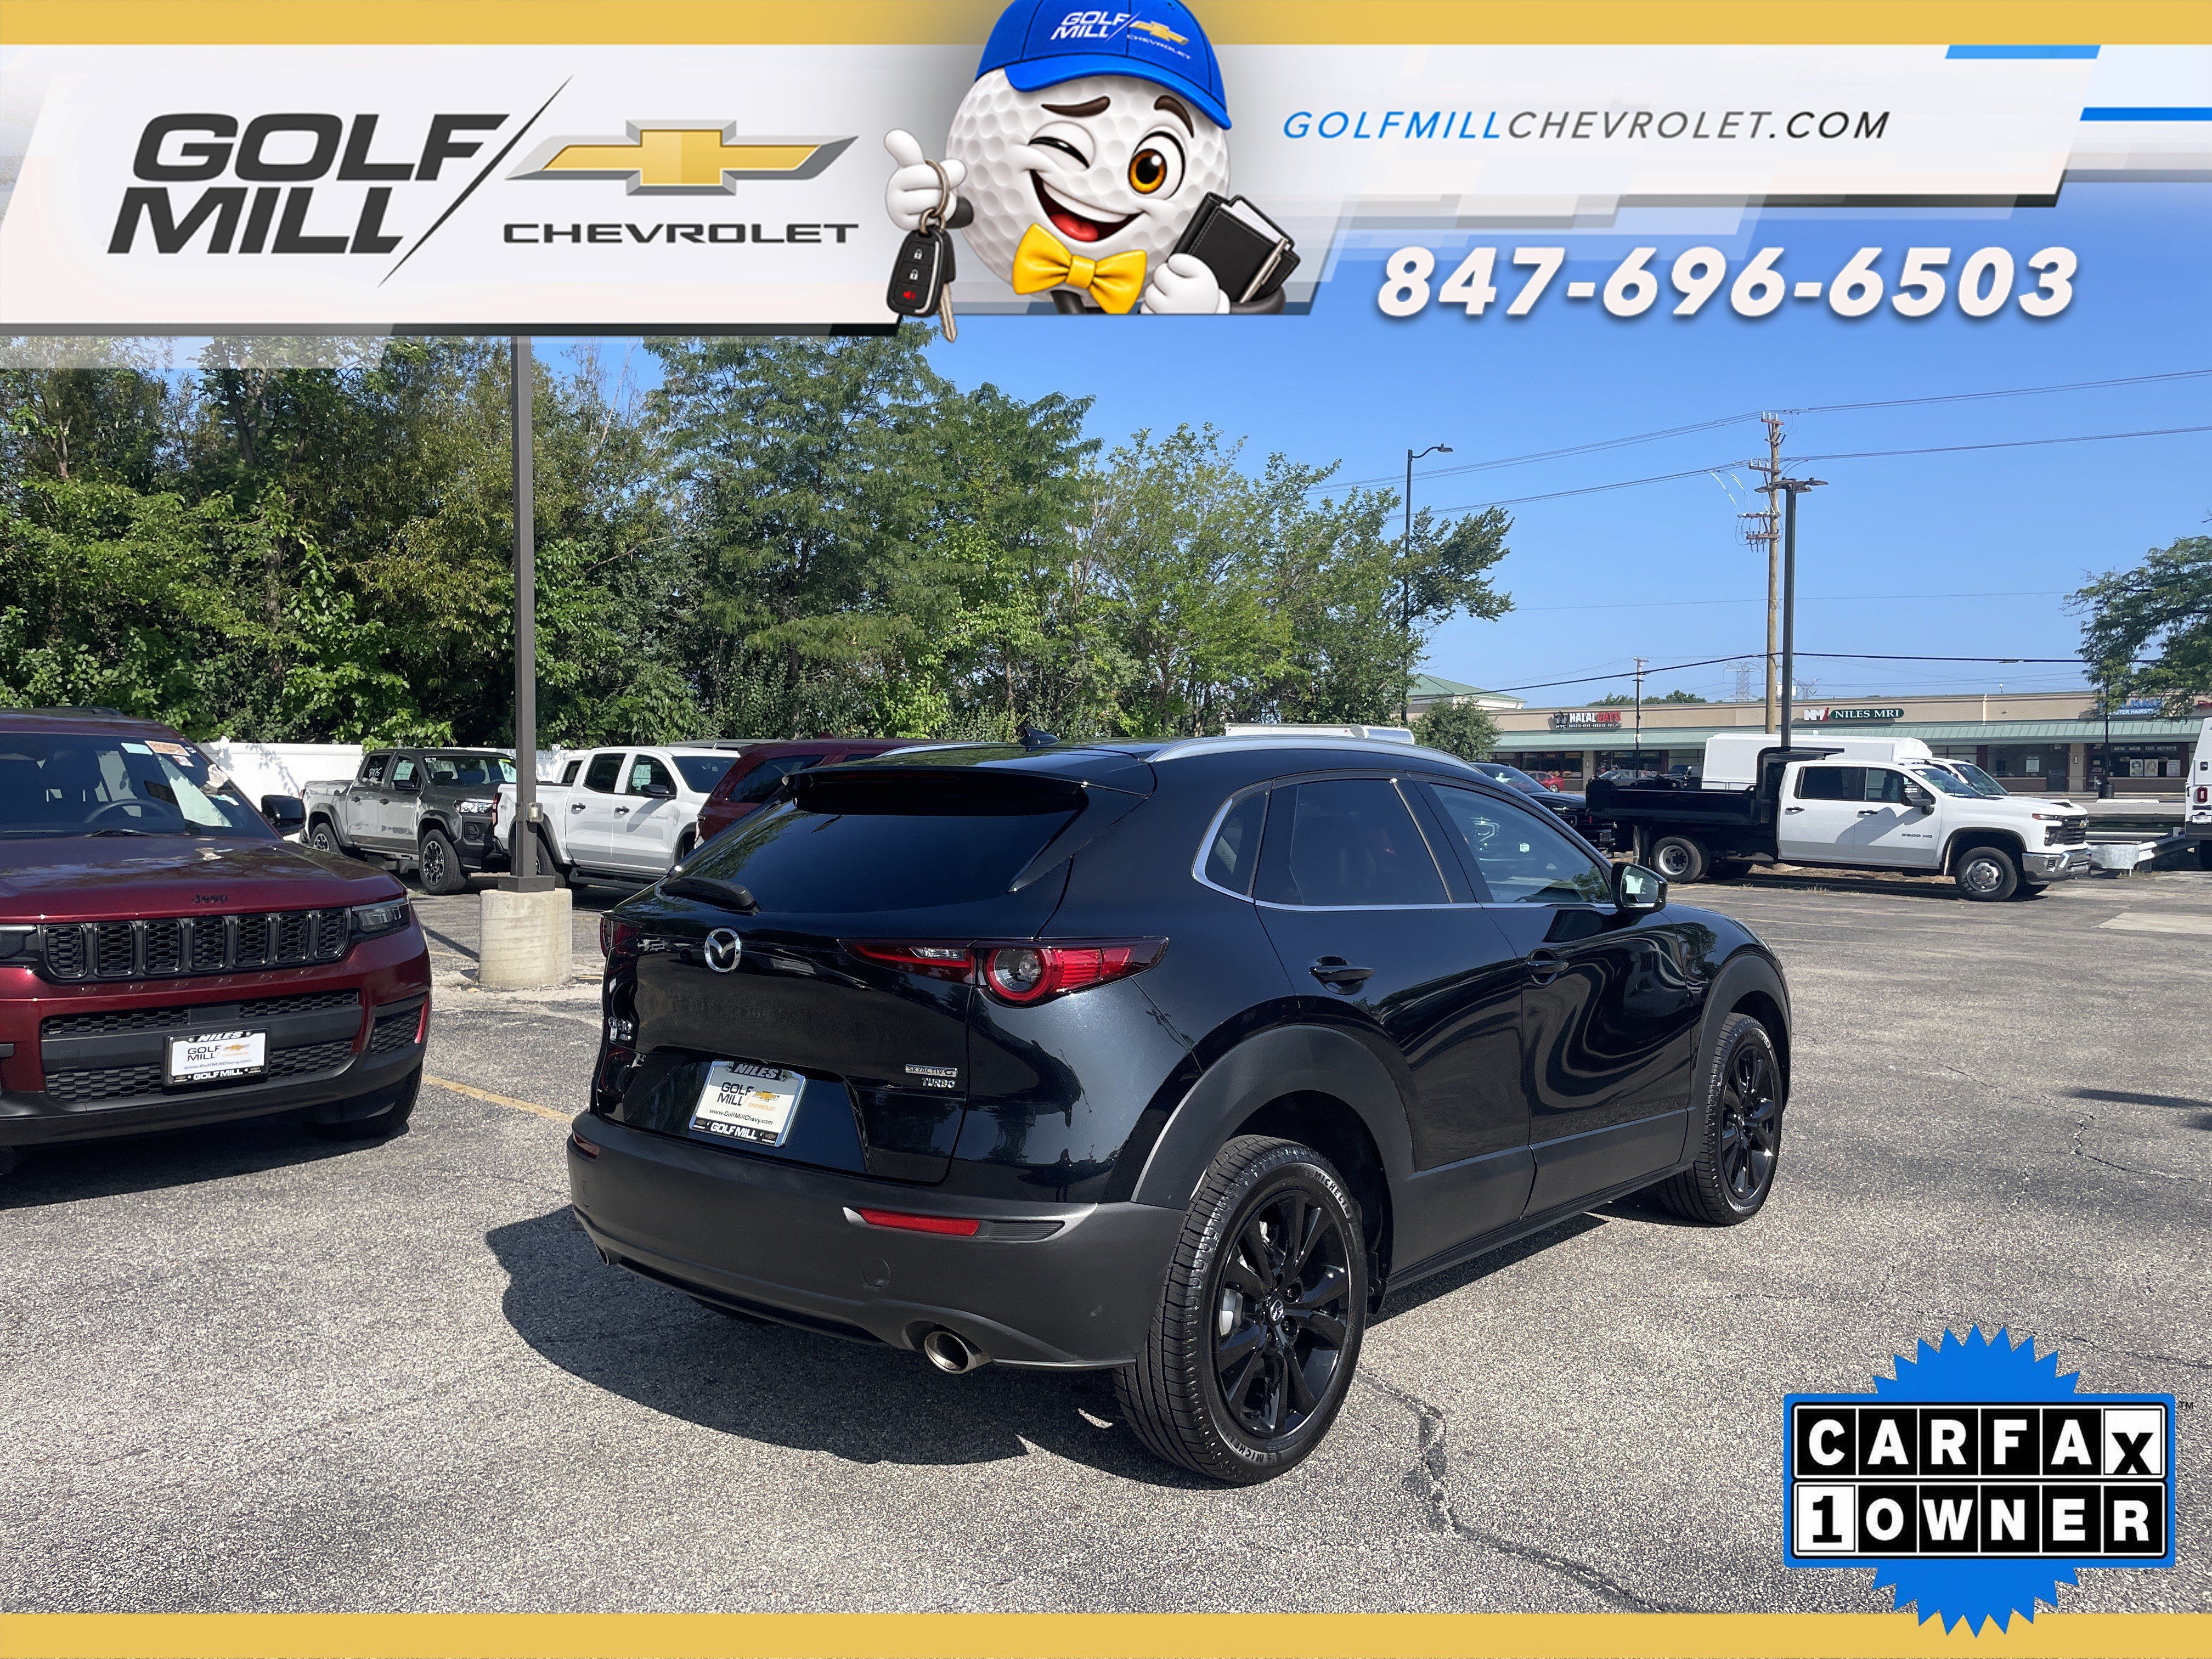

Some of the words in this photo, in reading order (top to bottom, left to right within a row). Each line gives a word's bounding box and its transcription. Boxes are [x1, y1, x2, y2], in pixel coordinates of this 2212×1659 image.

[1570, 713, 1596, 723] HALAL
[1597, 712, 1621, 722] EATS
[1835, 710, 1871, 718] NILES
[1874, 709, 1900, 718] MRI
[191, 894, 228, 904] Jeep
[197, 1031, 244, 1042] NILES
[187, 1045, 222, 1054] GOLF
[187, 1053, 215, 1062] MILL
[193, 1071, 219, 1080] GOLF
[220, 1069, 243, 1077] MILL
[734, 1064, 779, 1079] NILES
[922, 1077, 956, 1088] TURBO
[721, 1081, 754, 1096] GOLF
[716, 1092, 742, 1106] MILL
[709, 1109, 773, 1125] www.GolfMillChevy.com
[710, 1122, 735, 1135] GOLF
[734, 1126, 757, 1140] MILL
